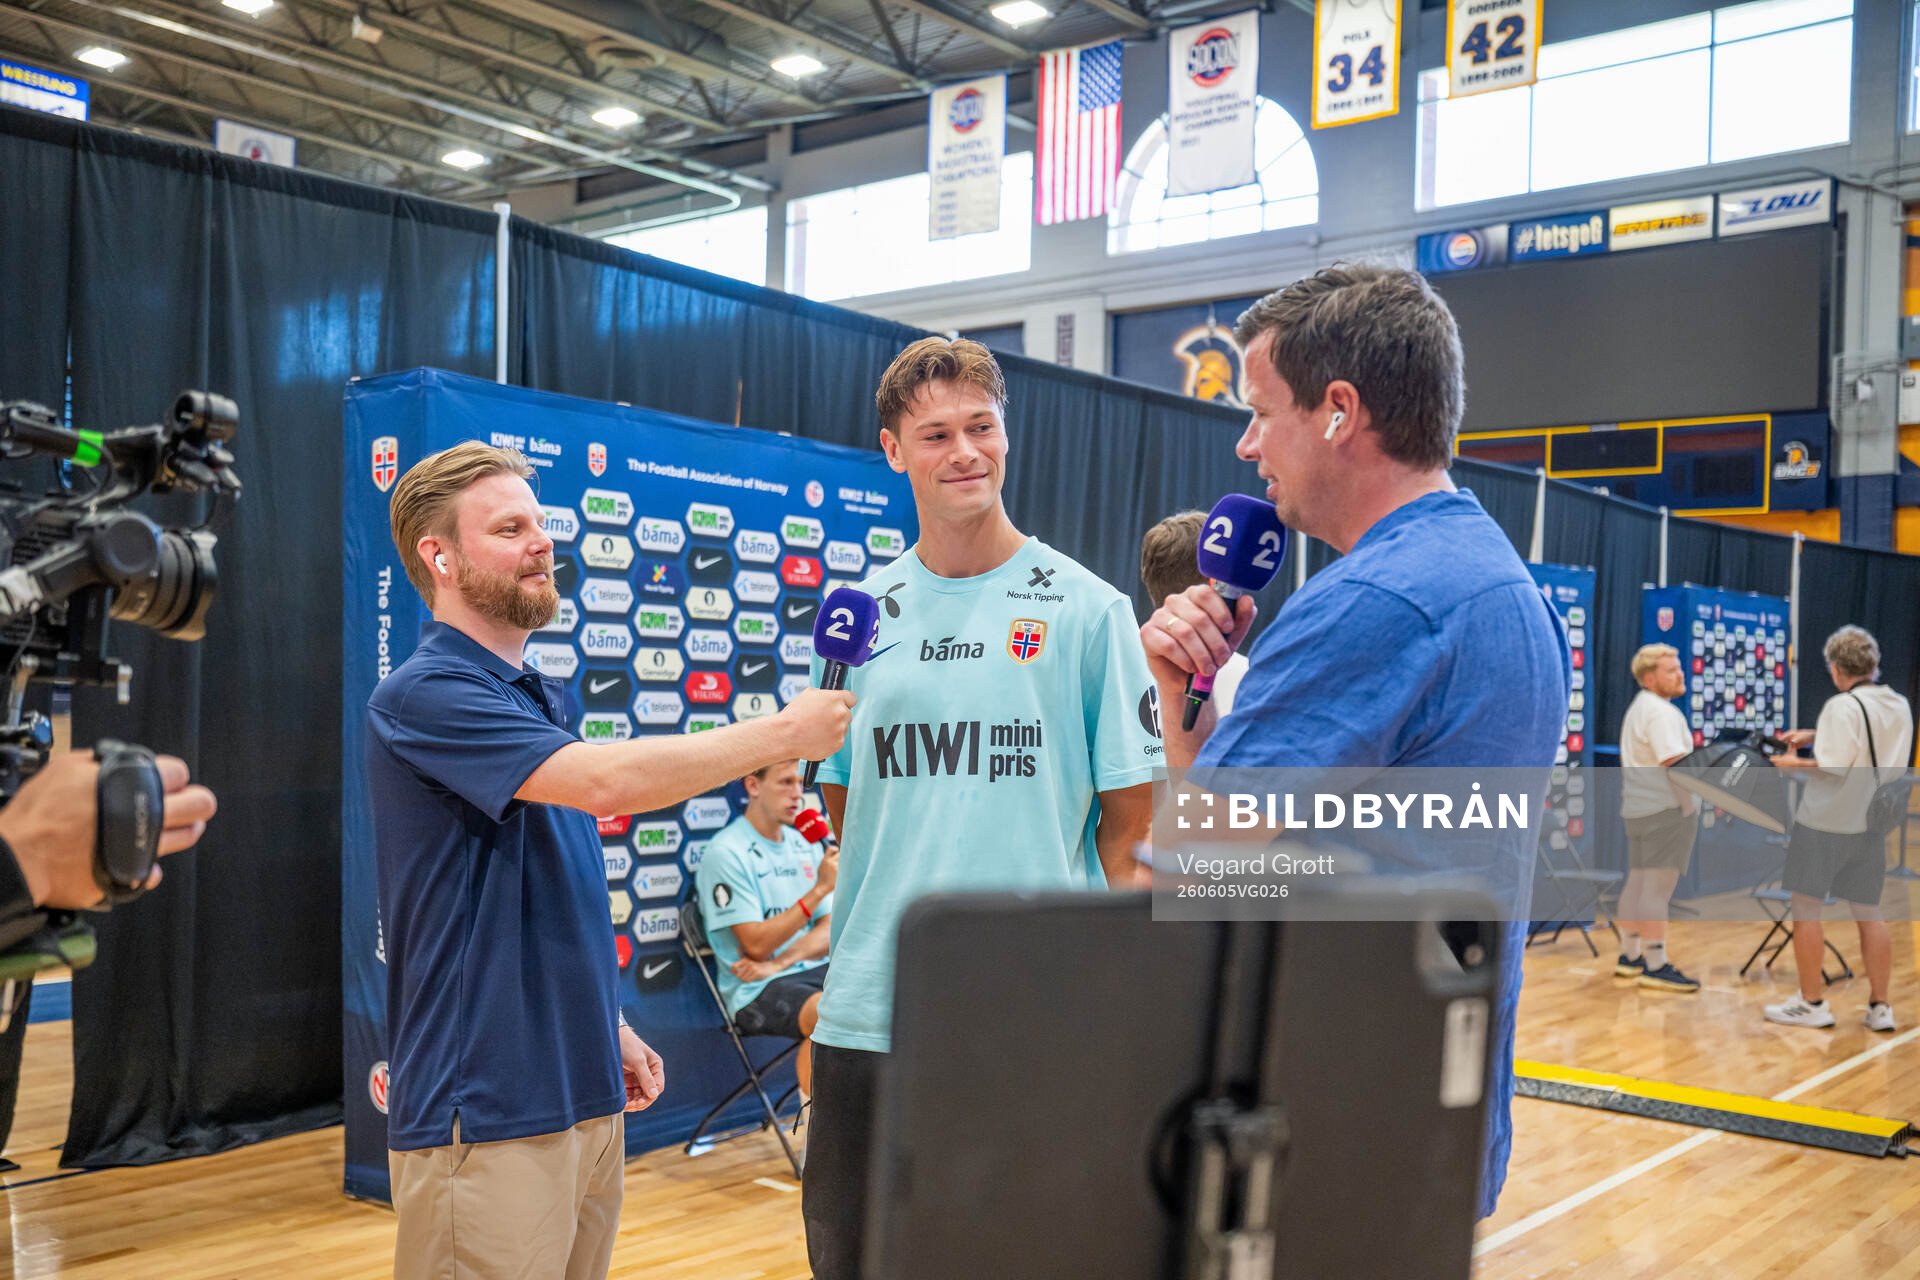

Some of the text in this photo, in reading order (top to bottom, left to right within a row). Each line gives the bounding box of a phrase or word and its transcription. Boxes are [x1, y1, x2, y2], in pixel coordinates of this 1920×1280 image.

[1461, 14, 1525, 65] 42
[1327, 45, 1386, 93] 34
[1, 64, 77, 96] WRESTLING
[627, 458, 789, 496] The Football Association of Norway
[587, 496, 616, 516] KIWI
[642, 524, 680, 544] bama
[1203, 516, 1233, 556] 2
[741, 536, 775, 555] bama
[1251, 530, 1280, 570] 2
[378, 565, 392, 609] The
[599, 589, 630, 601] telenor
[1007, 590, 1065, 602] Norsk Tipping
[826, 607, 854, 641] 2
[378, 615, 392, 680] Footb
[587, 629, 627, 649] bama
[692, 635, 727, 653] bama
[786, 640, 811, 657] bam
[919, 635, 985, 662] bama
[542, 655, 575, 666] telenor
[692, 690, 724, 700] VIKING
[651, 702, 679, 712] telenor
[990, 718, 1042, 748] mini
[873, 720, 981, 780] KIWI
[989, 748, 1036, 782] pris
[598, 821, 623, 832] KING
[606, 857, 626, 871] ma
[651, 872, 679, 886] telenor
[641, 914, 678, 935] bama
